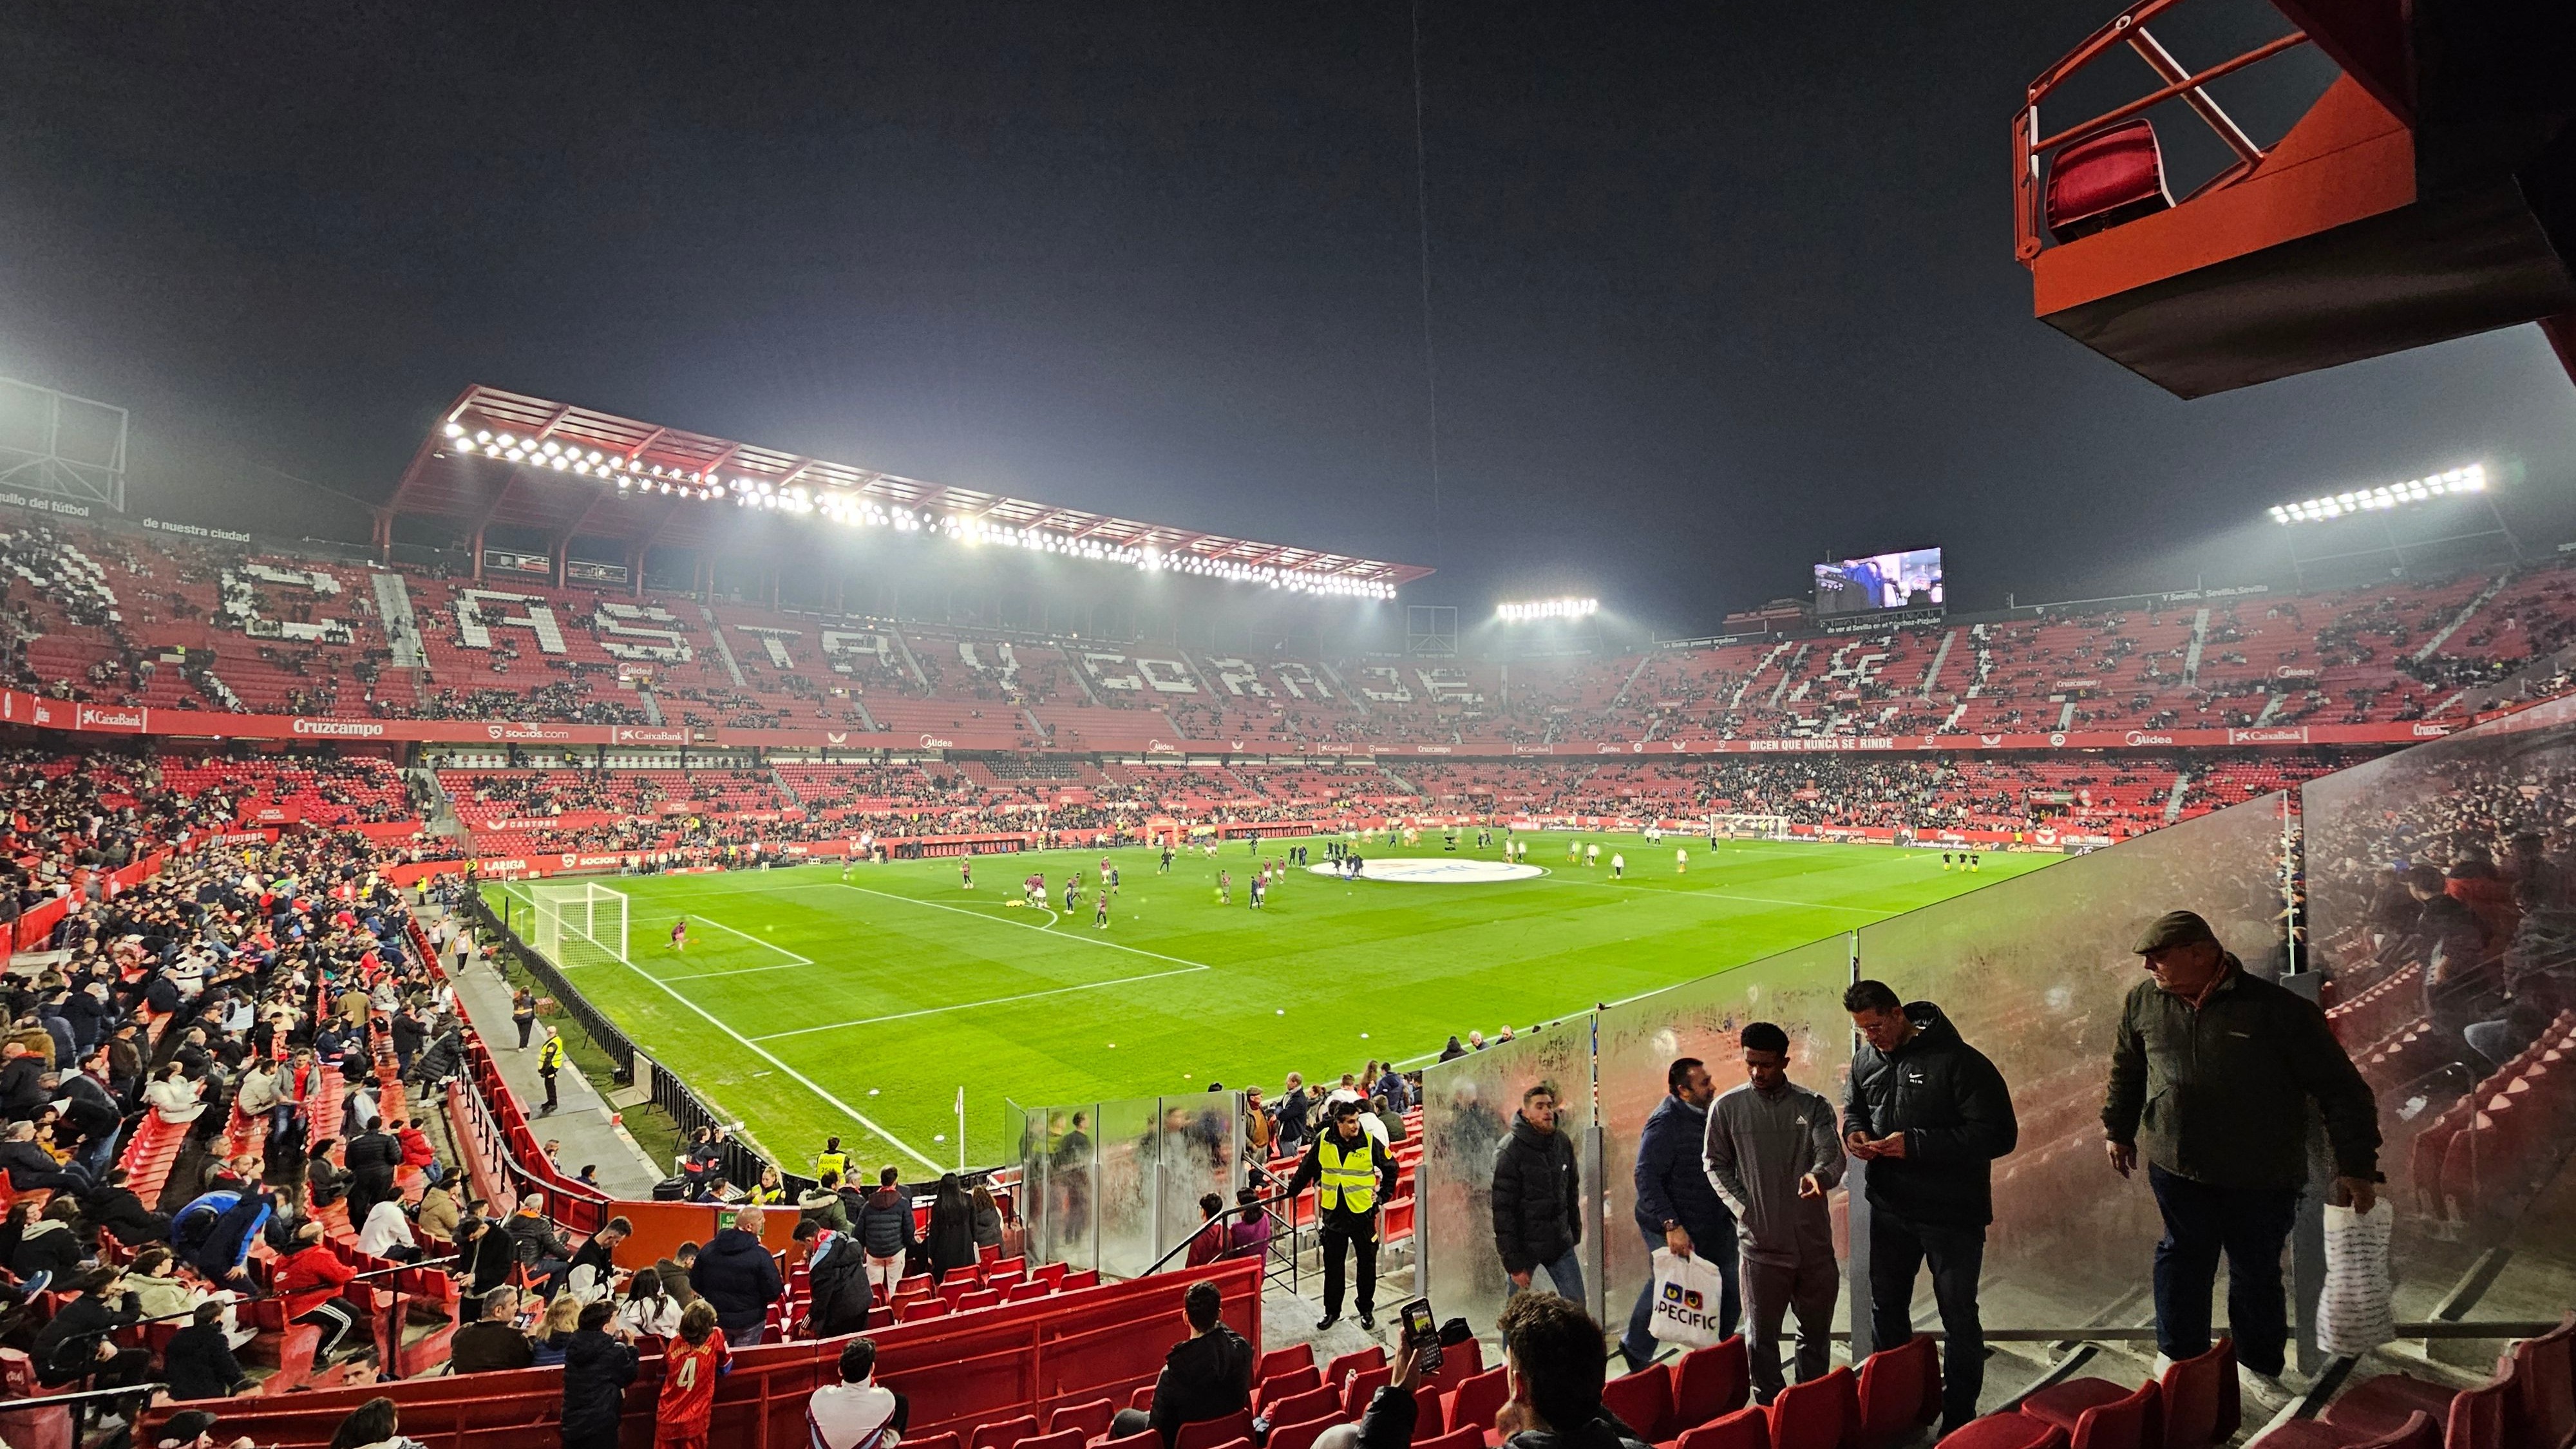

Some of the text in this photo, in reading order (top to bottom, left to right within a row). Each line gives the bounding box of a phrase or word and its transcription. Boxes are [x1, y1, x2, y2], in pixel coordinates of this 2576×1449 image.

[29, 497, 48, 511] del
[52, 500, 89, 516] fútbol
[143, 517, 251, 542] de nuestra ciudad
[96, 711, 141, 726] CaixaBank
[293, 718, 383, 737] Cruzcampo
[635, 730, 683, 741] CaixaBank
[2251, 730, 2302, 741] CaixaBank
[1750, 737, 1893, 751] DICEN QUE NUNCA SE RINDE
[509, 819, 558, 828] CASTORE
[1654, 1300, 1717, 1331] PECIFIC
[676, 1356, 697, 1392] 4
